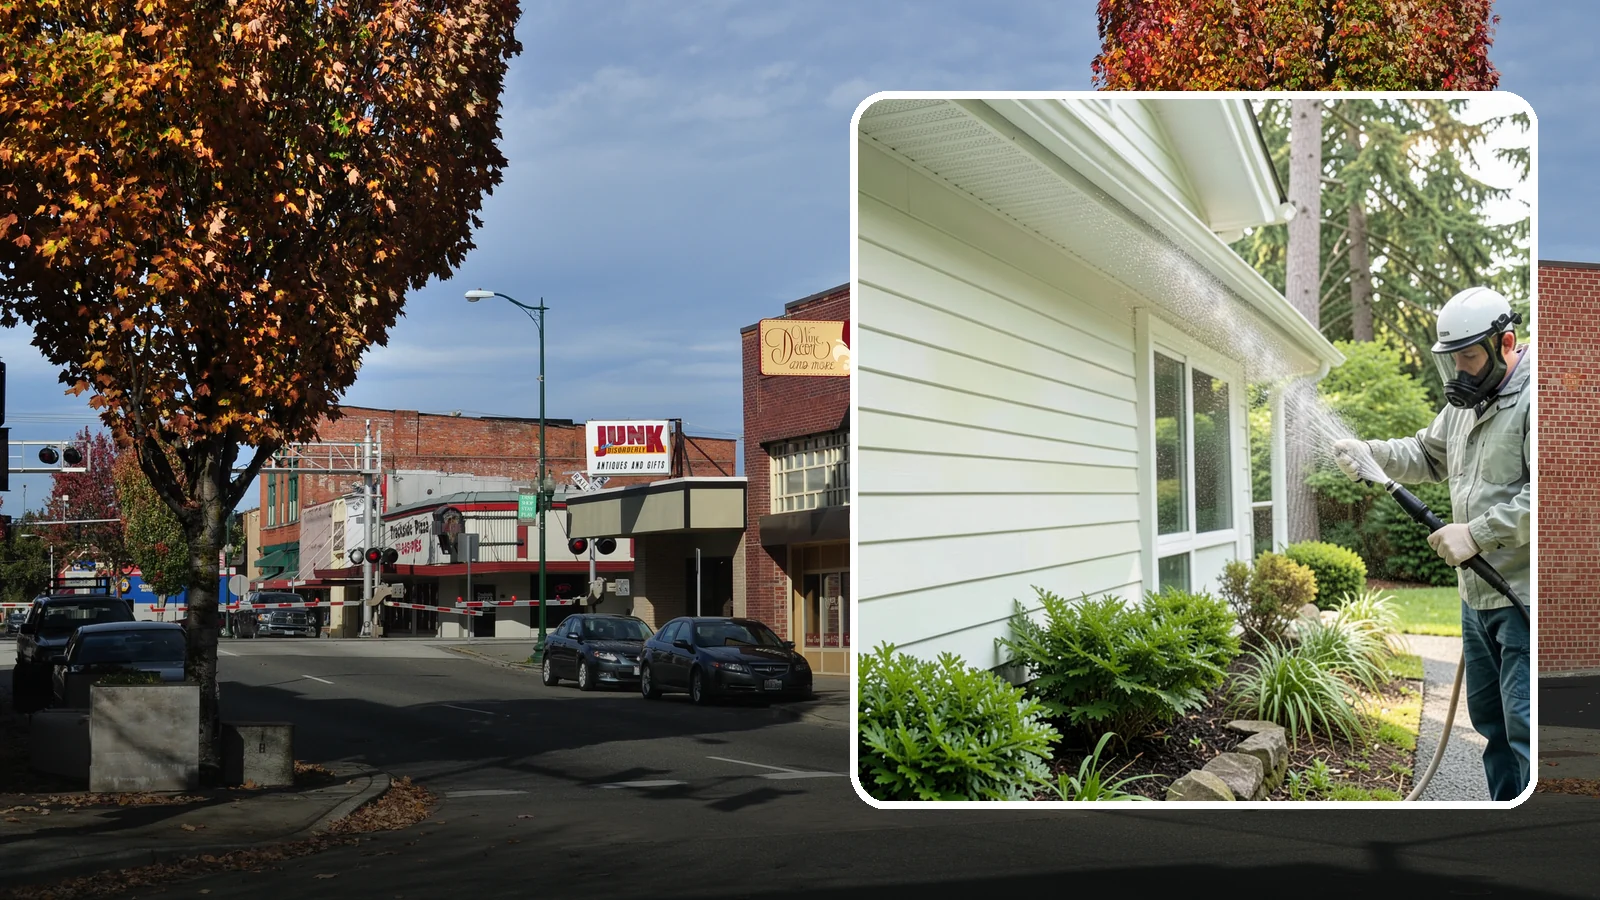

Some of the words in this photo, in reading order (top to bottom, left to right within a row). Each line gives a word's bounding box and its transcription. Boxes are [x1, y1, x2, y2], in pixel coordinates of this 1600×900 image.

[595, 425, 665, 457] JUNK
[607, 446, 646, 454] DISORDERLY
[597, 461, 628, 470] ANTIQUES
[631, 460, 644, 469] AND
[647, 460, 665, 469] GIFTS
[390, 521, 413, 539] Trackside
[415, 519, 429, 535] Pizza
